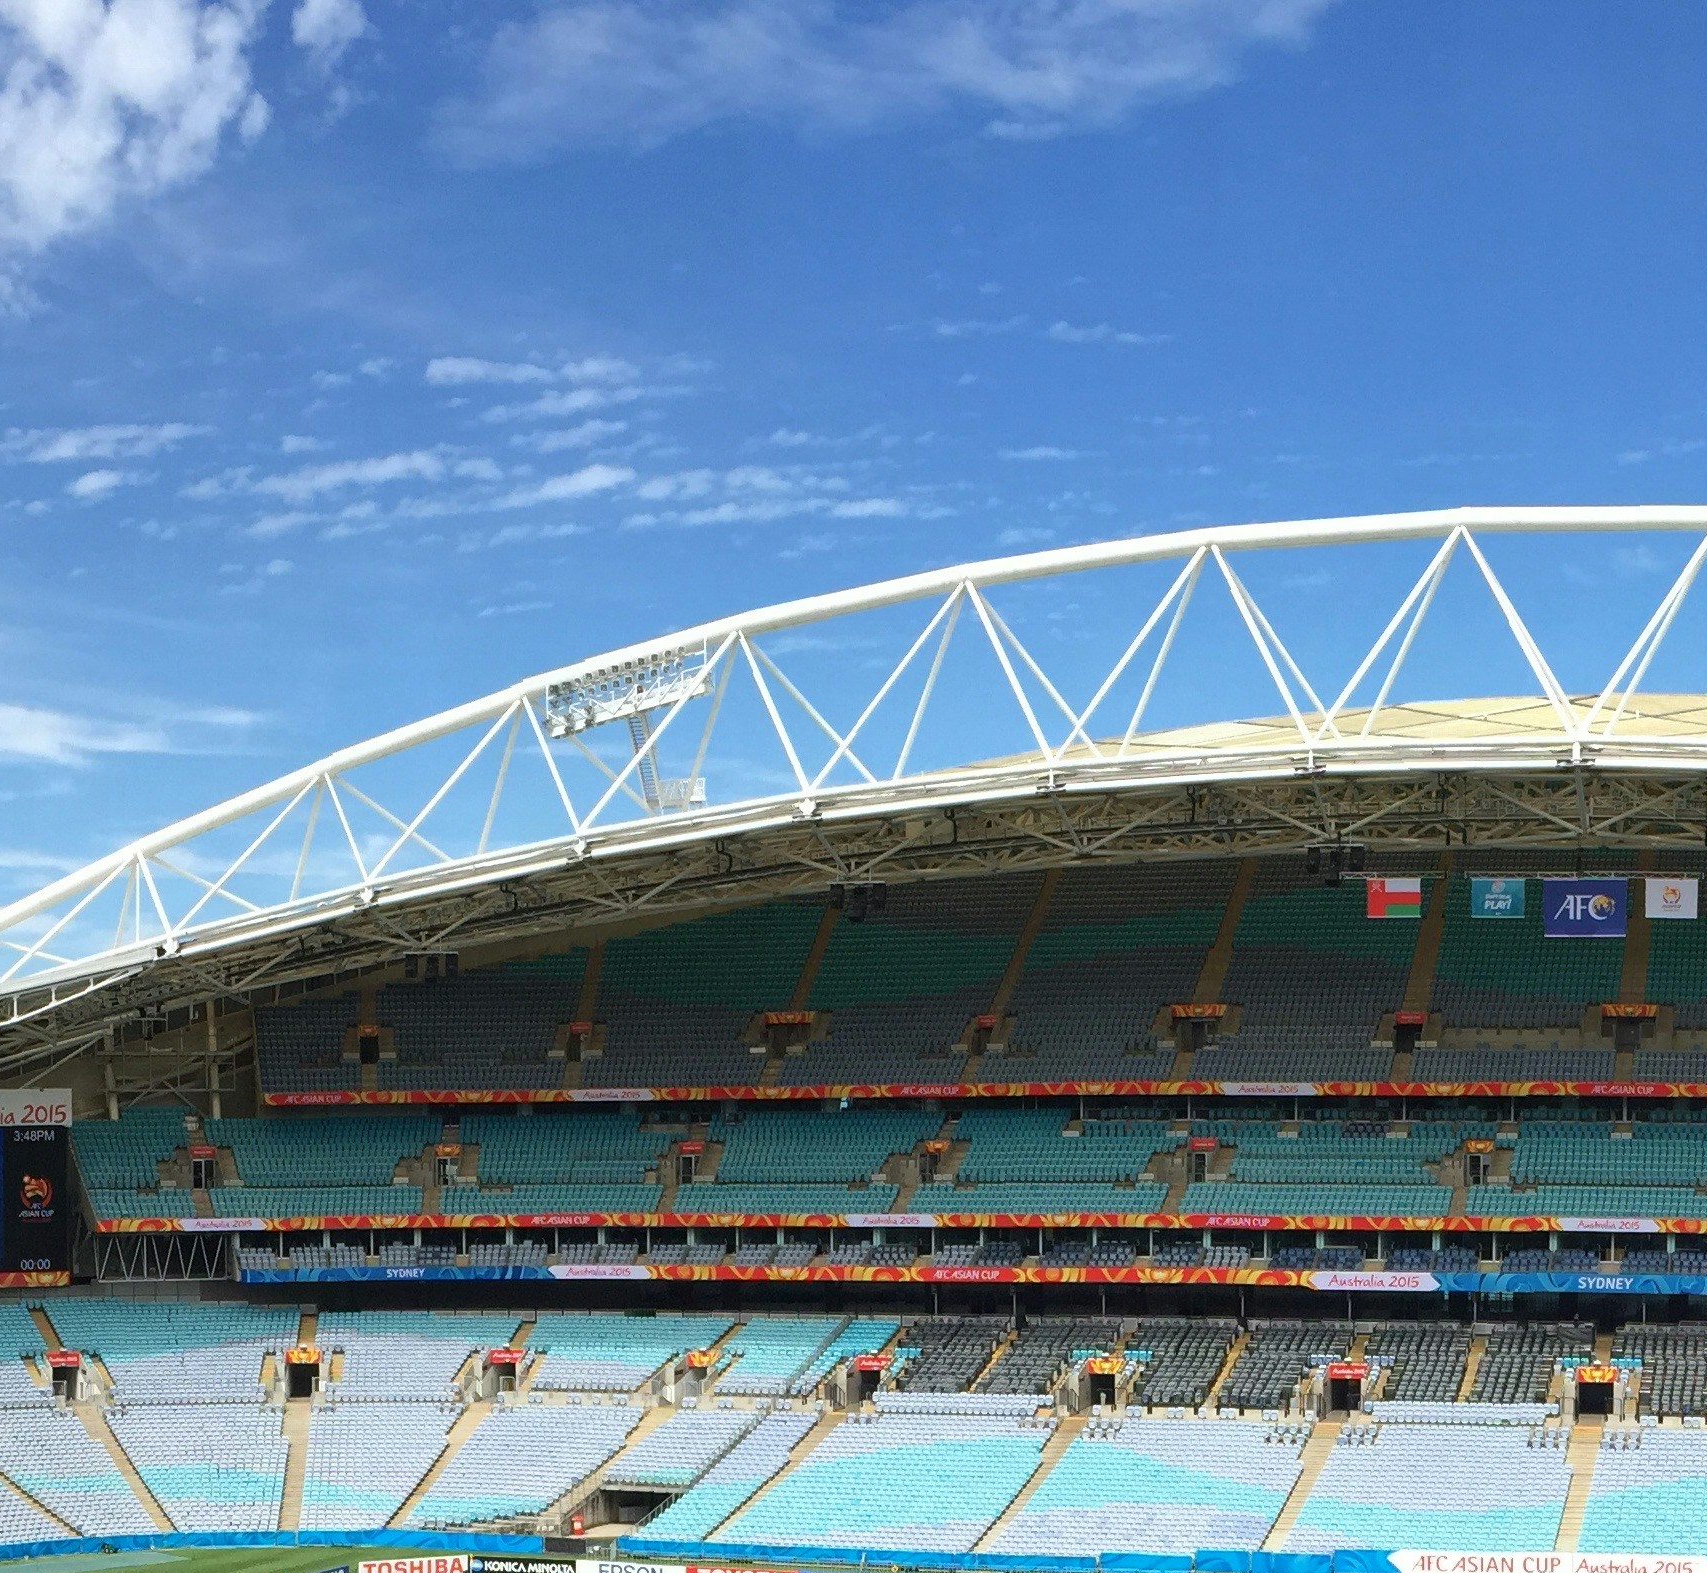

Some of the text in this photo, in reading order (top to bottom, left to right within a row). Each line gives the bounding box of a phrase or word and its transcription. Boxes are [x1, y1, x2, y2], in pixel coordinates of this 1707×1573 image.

[1554, 895, 1609, 920] AFC
[21, 1104, 66, 1124] 2015
[13, 1130, 55, 1142] 3:48PM
[20, 1259, 51, 1270] 00:00
[386, 1268, 425, 1278] SYDNEY
[1328, 1274, 1419, 1288] Australia 2015
[1578, 1277, 1634, 1290] SYDNEY
[484, 1560, 526, 1573] KONICA
[1413, 1555, 1447, 1572] AFC
[1453, 1556, 1514, 1573] ASIAN
[1523, 1557, 1561, 1573] CUP
